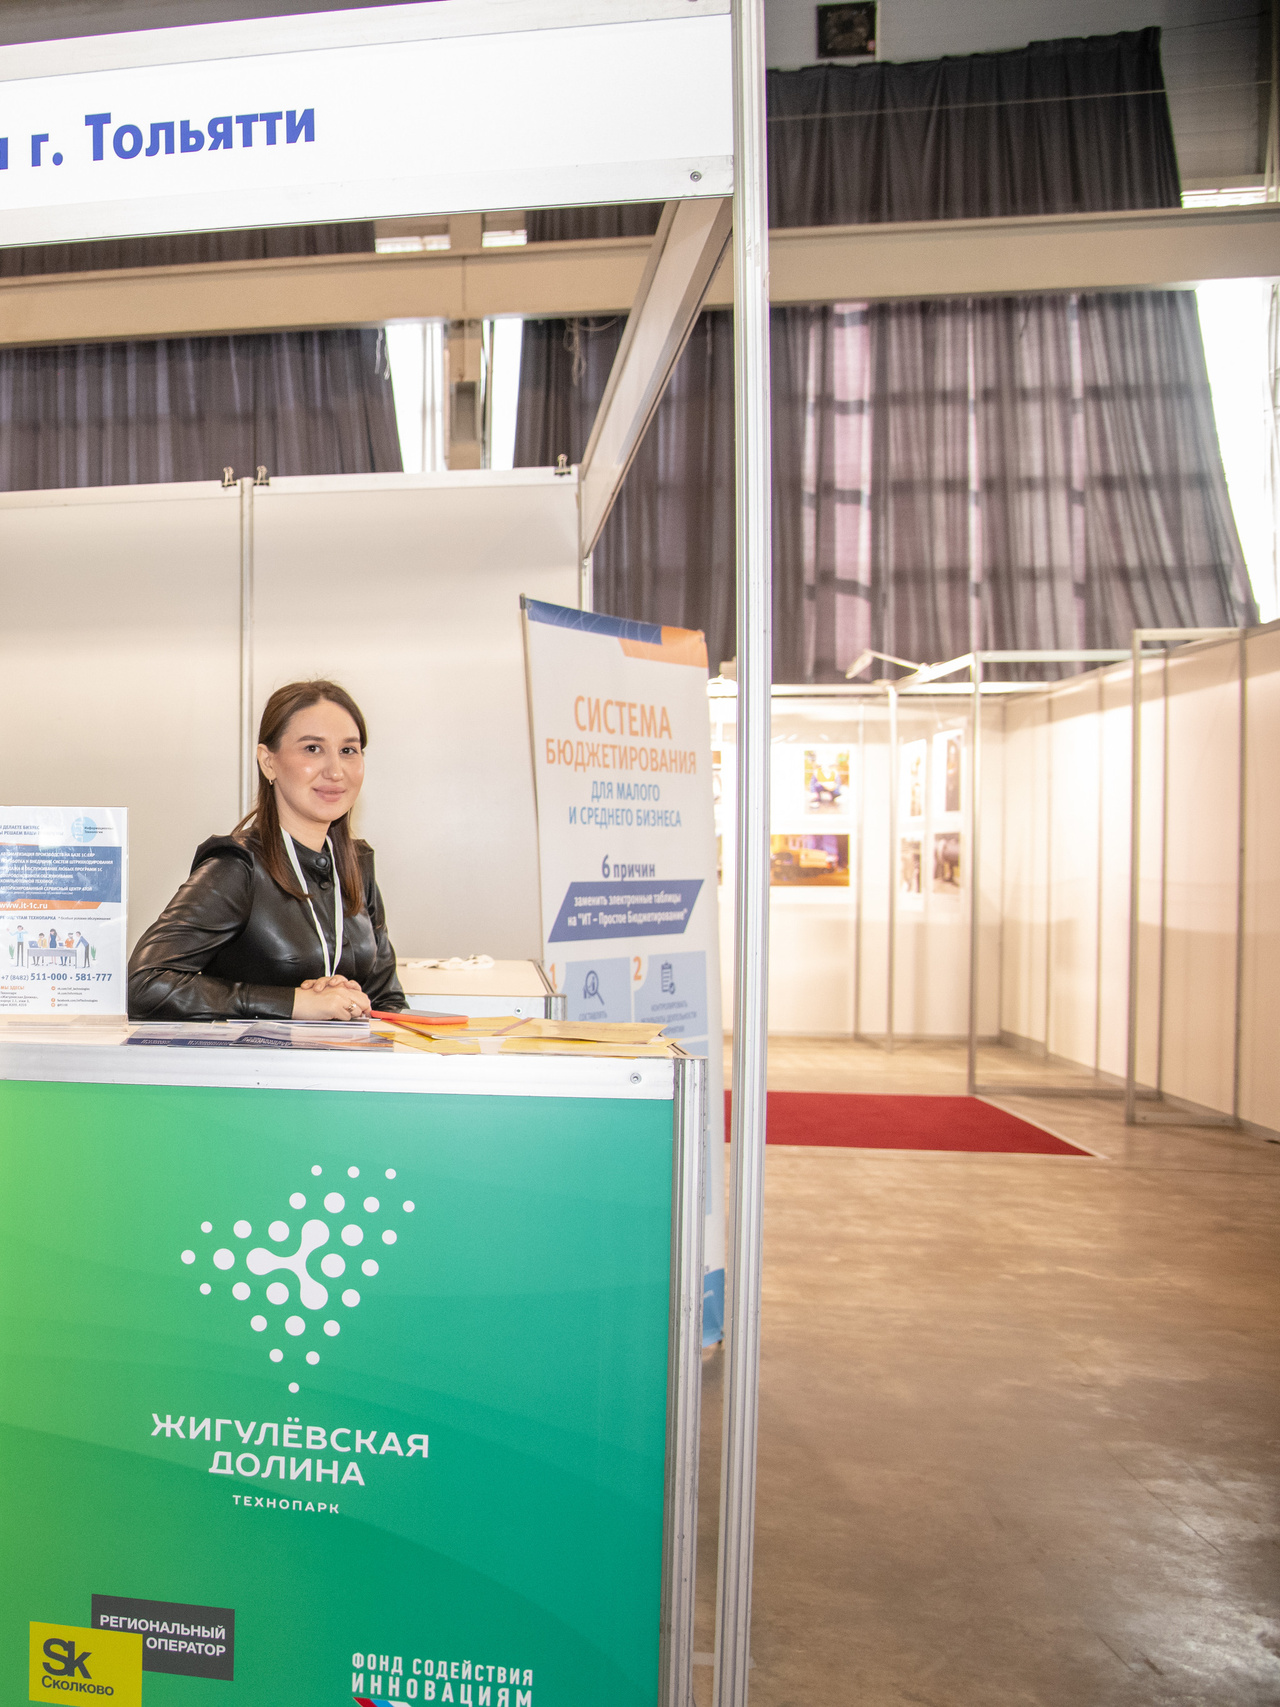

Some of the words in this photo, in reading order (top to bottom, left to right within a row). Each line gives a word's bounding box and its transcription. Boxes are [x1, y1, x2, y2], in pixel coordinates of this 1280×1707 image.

[30, 132, 63, 168] г.
[85, 107, 316, 161] Тольятти
[574, 695, 672, 739] СИСТЕМА
[546, 737, 696, 775] БЮДЖЕТИРОВАНИЯ
[591, 780, 613, 801] ДЛЯ
[616, 782, 660, 802] МАЛОГО
[569, 806, 577, 825] И
[580, 807, 633, 829] СРЕДНЕГО
[636, 808, 682, 827] БИЗНЕСА
[602, 855, 610, 879] 6
[613, 861, 655, 881] причин
[574, 895, 608, 907] заменить
[609, 893, 652, 907] электронные
[653, 891, 682, 906] таблицы
[567, 915, 577, 927] на
[599, 911, 626, 927] Простое
[30, 973, 67, 981] 511-000
[75, 973, 112, 981] 581-777
[633, 956, 642, 981] 2
[151, 1412, 429, 1458] ЖИГУЛЁВСКАЯ
[208, 1450, 365, 1486] ДОЛИНА
[232, 1494, 339, 1514] ТЕХНОПАРК
[99, 1614, 226, 1641] РЕГИОНАЛЬНЫЙ
[42, 1637, 92, 1680] Sk
[146, 1636, 226, 1658] ОПЕРАТОР
[352, 1652, 403, 1675] ФОНД
[412, 1658, 533, 1686] СОДЕЙСТВИЯ
[41, 1675, 115, 1696] Сколково
[351, 1672, 532, 1707] ИННОВАЦИЯМ
